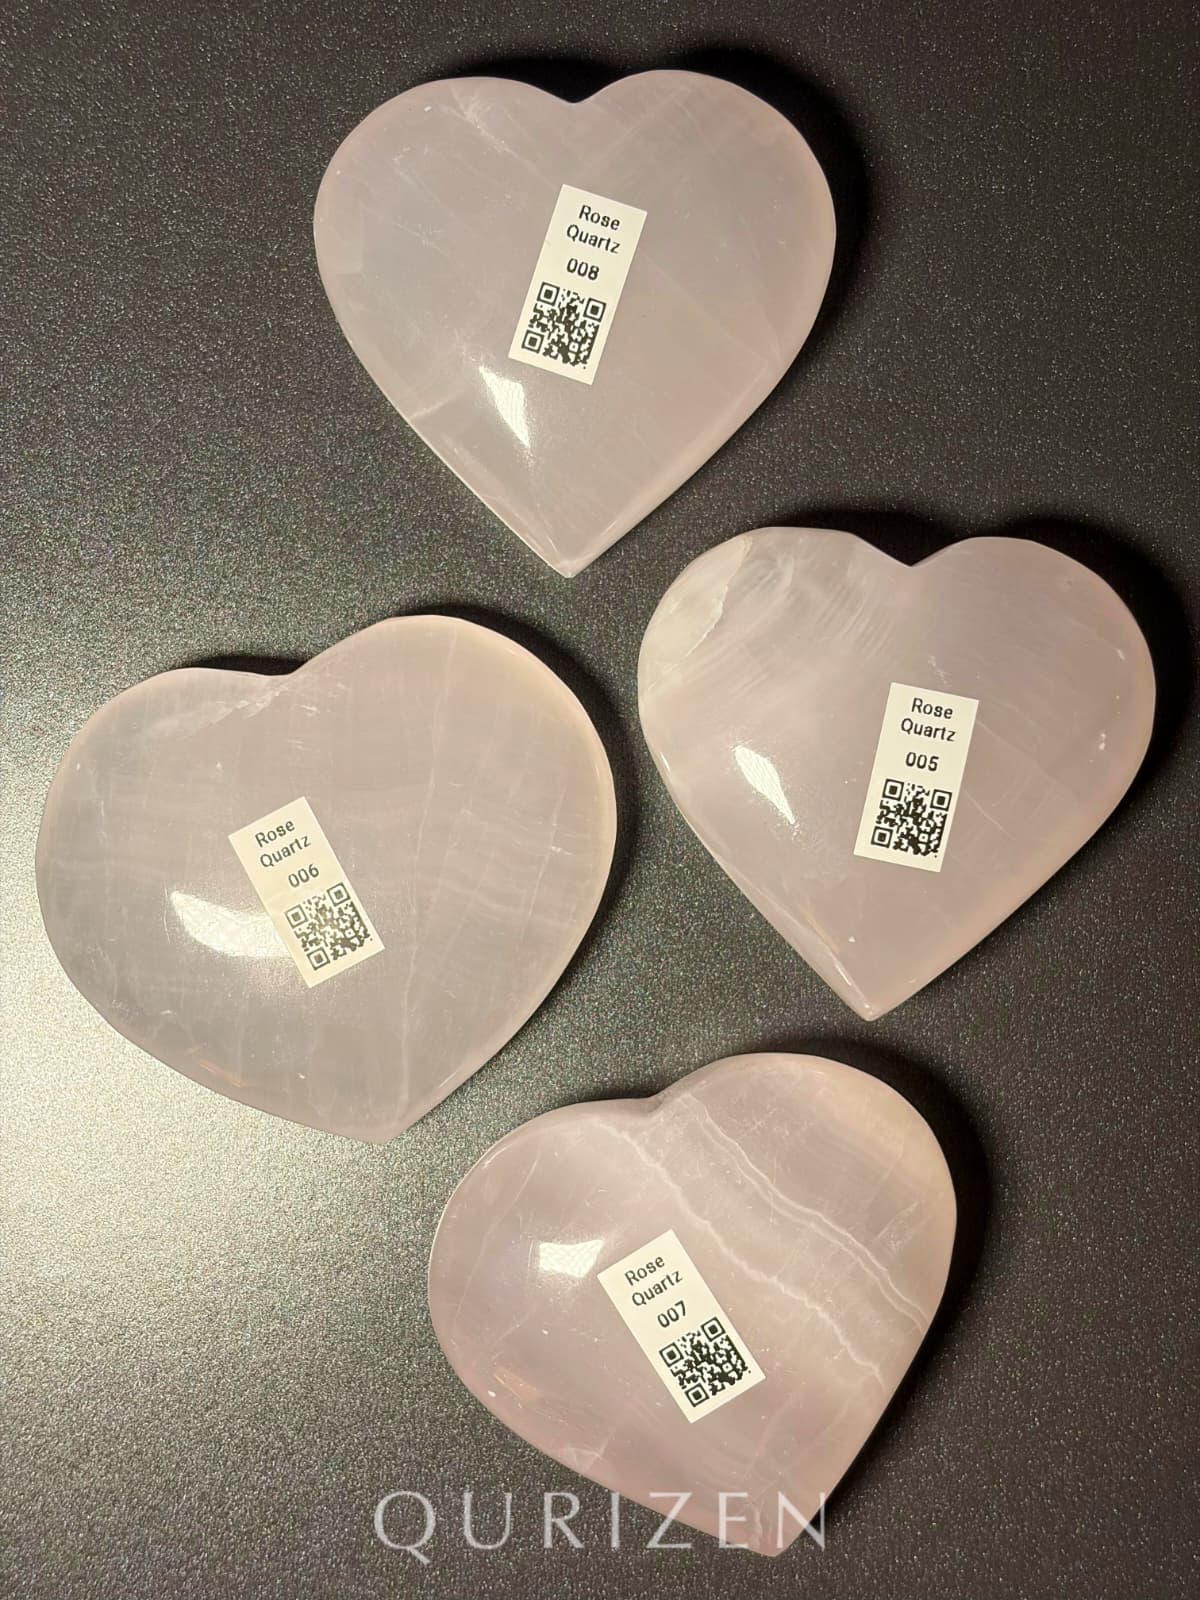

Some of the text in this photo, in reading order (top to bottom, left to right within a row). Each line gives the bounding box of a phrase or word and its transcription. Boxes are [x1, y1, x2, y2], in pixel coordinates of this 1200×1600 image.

[578, 204, 621, 230] Rose
[566, 224, 622, 255] Quartz
[566, 258, 599, 281] 008
[911, 698, 953, 720] Rose
[900, 718, 956, 742] Quartz
[905, 751, 939, 772] 005
[254, 819, 296, 849] Rose
[259, 835, 312, 870] Quartz
[287, 863, 320, 889] 006
[625, 1254, 666, 1286] Rose
[631, 1271, 683, 1307] Quartz
[656, 1300, 688, 1329] 007
